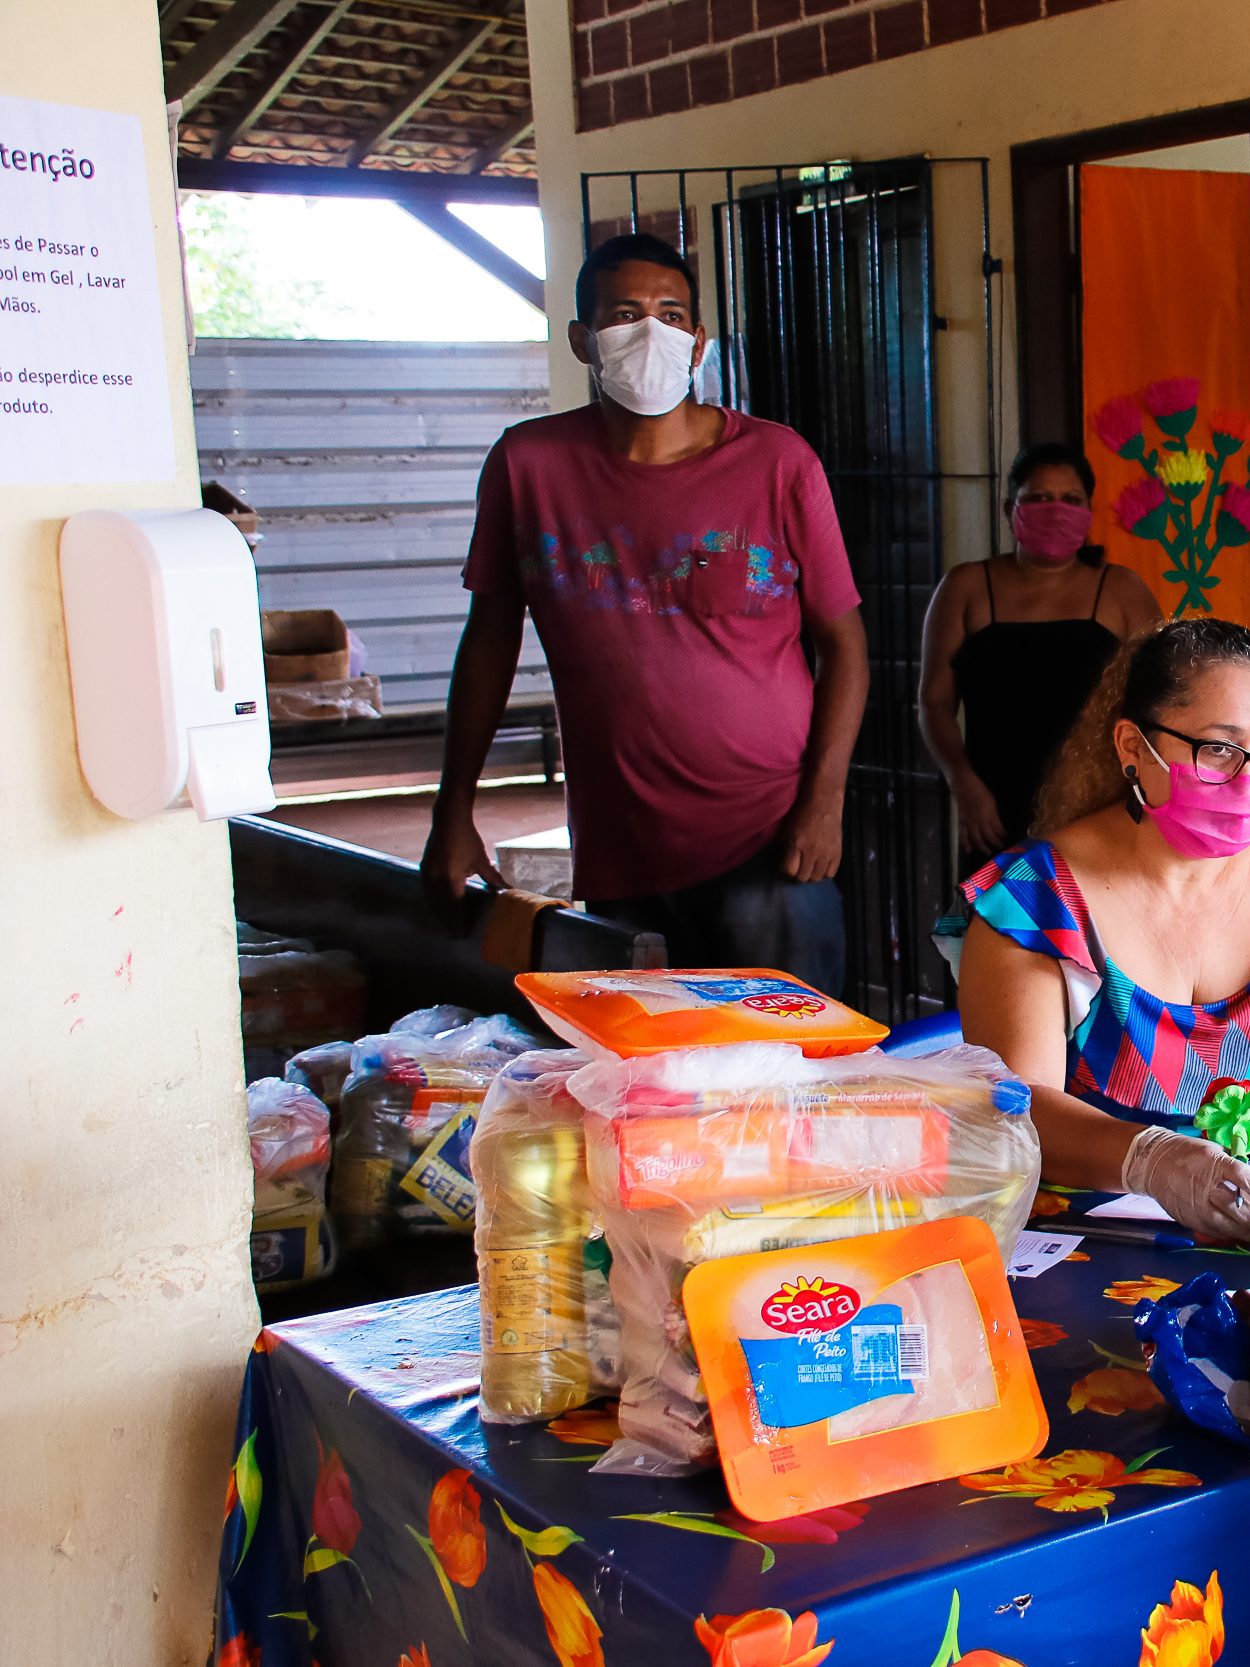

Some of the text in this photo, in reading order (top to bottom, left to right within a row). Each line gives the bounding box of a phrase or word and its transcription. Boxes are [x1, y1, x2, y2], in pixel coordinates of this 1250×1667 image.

[0, 142, 96, 183] tenção
[15, 235, 34, 252] de
[38, 238, 86, 257] Passar
[90, 245, 99, 258] o
[22, 270, 47, 284] em
[50, 269, 74, 286] Gel
[87, 272, 126, 289] Lavar
[18, 367, 99, 388] desperdice
[102, 373, 133, 386] esse
[751, 992, 823, 1011] Seara
[766, 1294, 856, 1326] Seara
[824, 1330, 841, 1343] de
[813, 1342, 847, 1360] Peito
